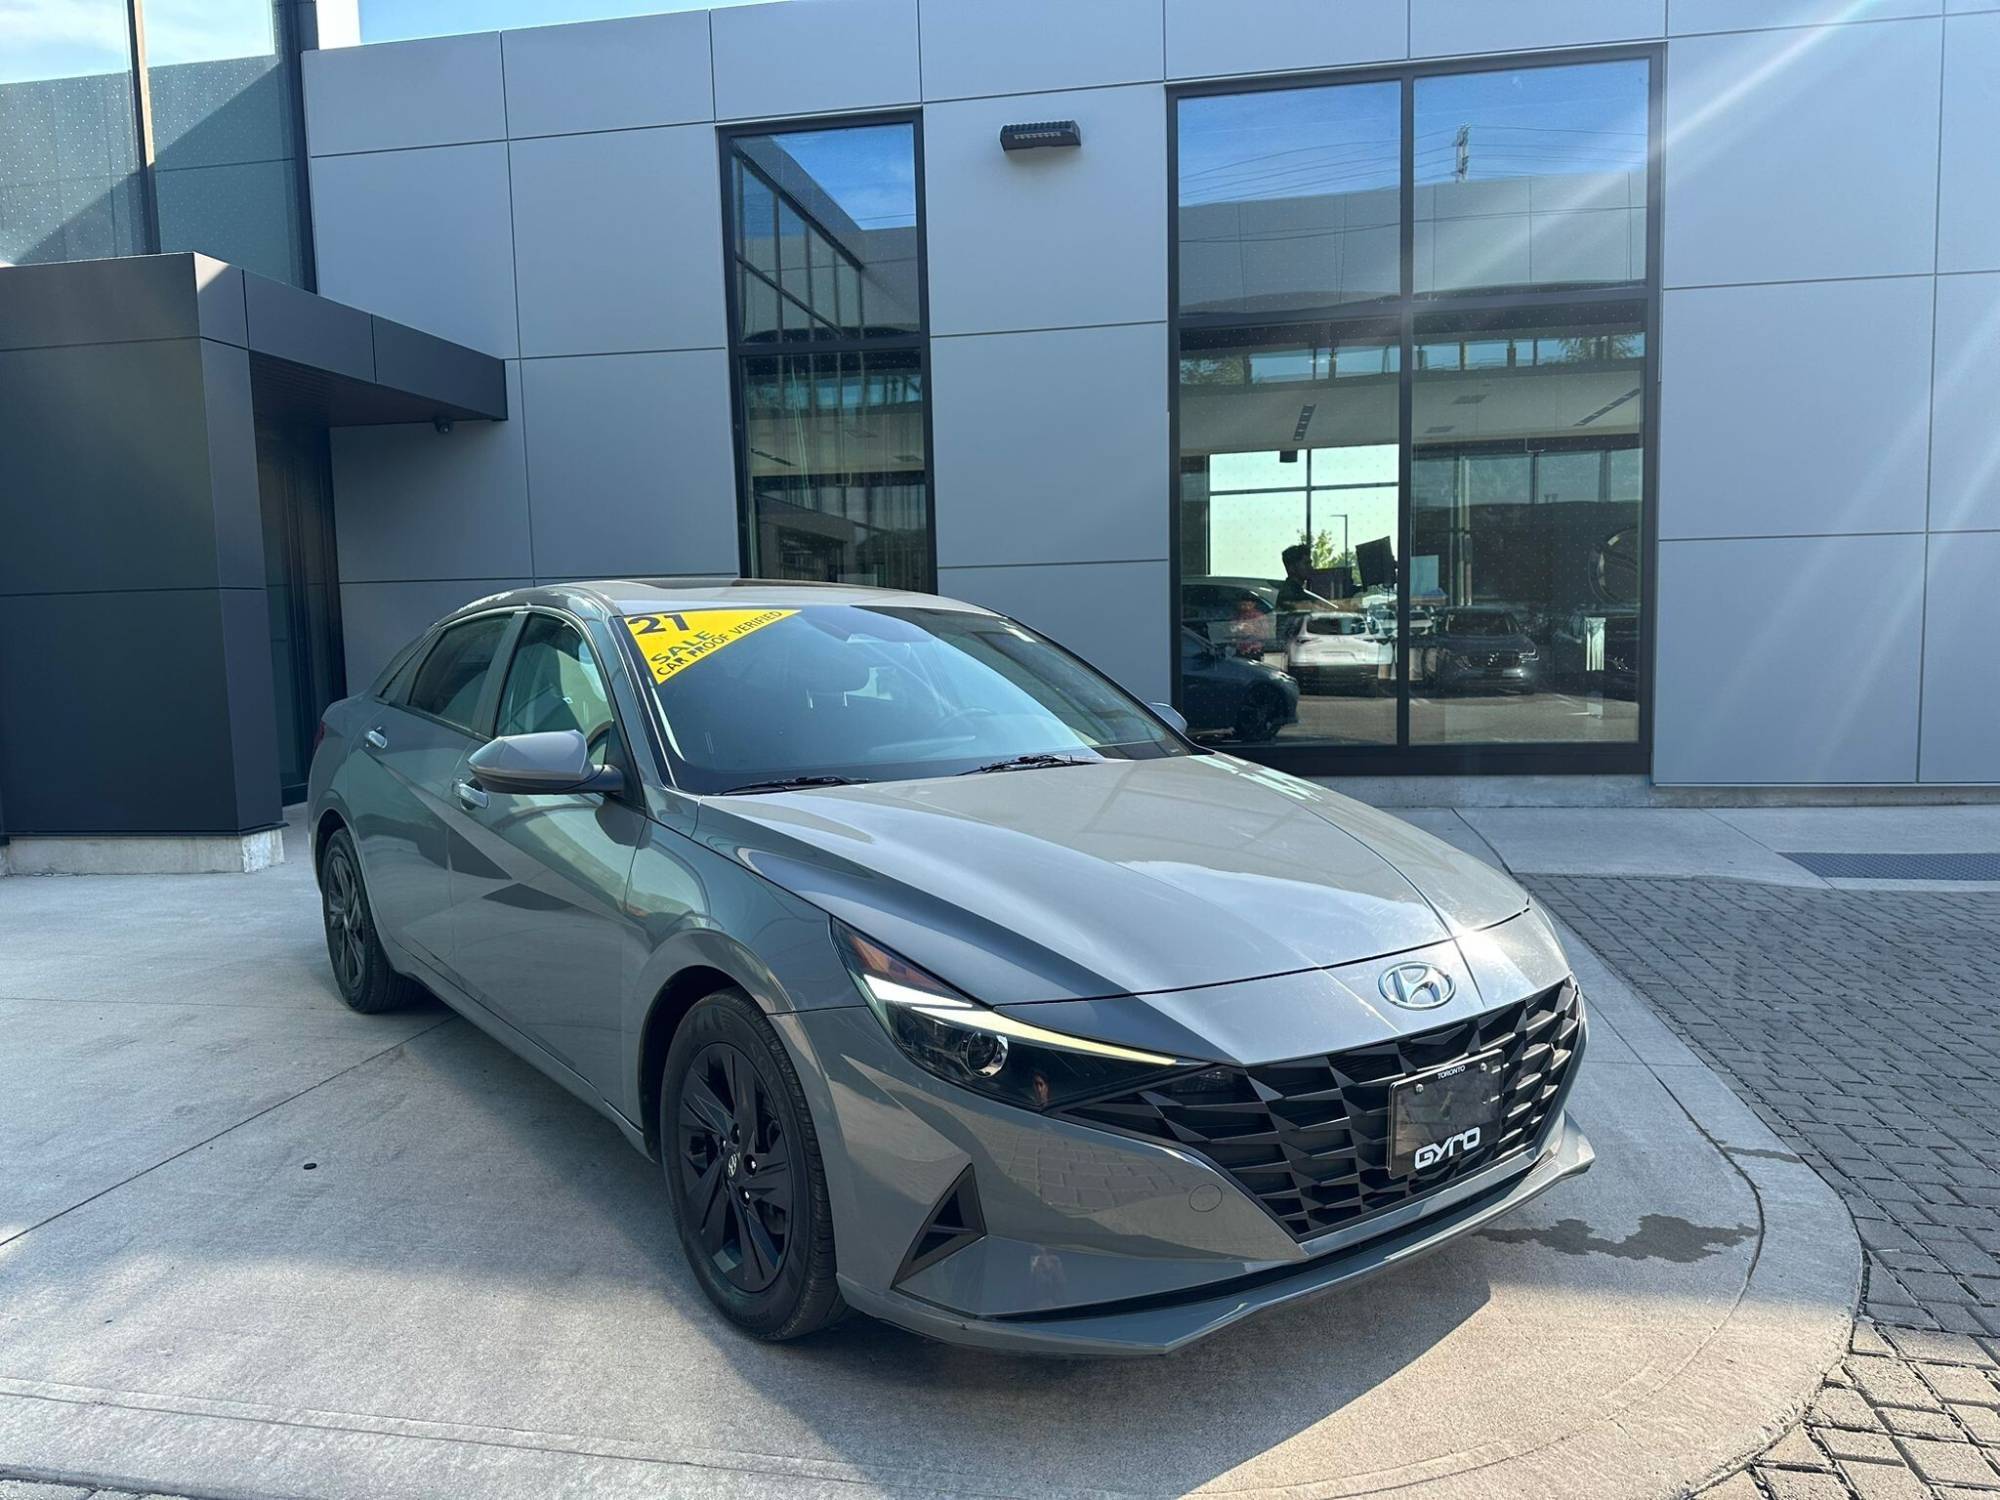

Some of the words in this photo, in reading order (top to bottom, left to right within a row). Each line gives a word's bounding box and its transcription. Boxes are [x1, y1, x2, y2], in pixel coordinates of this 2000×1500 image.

[650, 630, 714, 665] SALE
[657, 658, 688, 676] CAR
[687, 633, 730, 657] PROOF
[729, 610, 783, 635] VERIFIED
[1437, 1065, 1466, 1080] TORONTO
